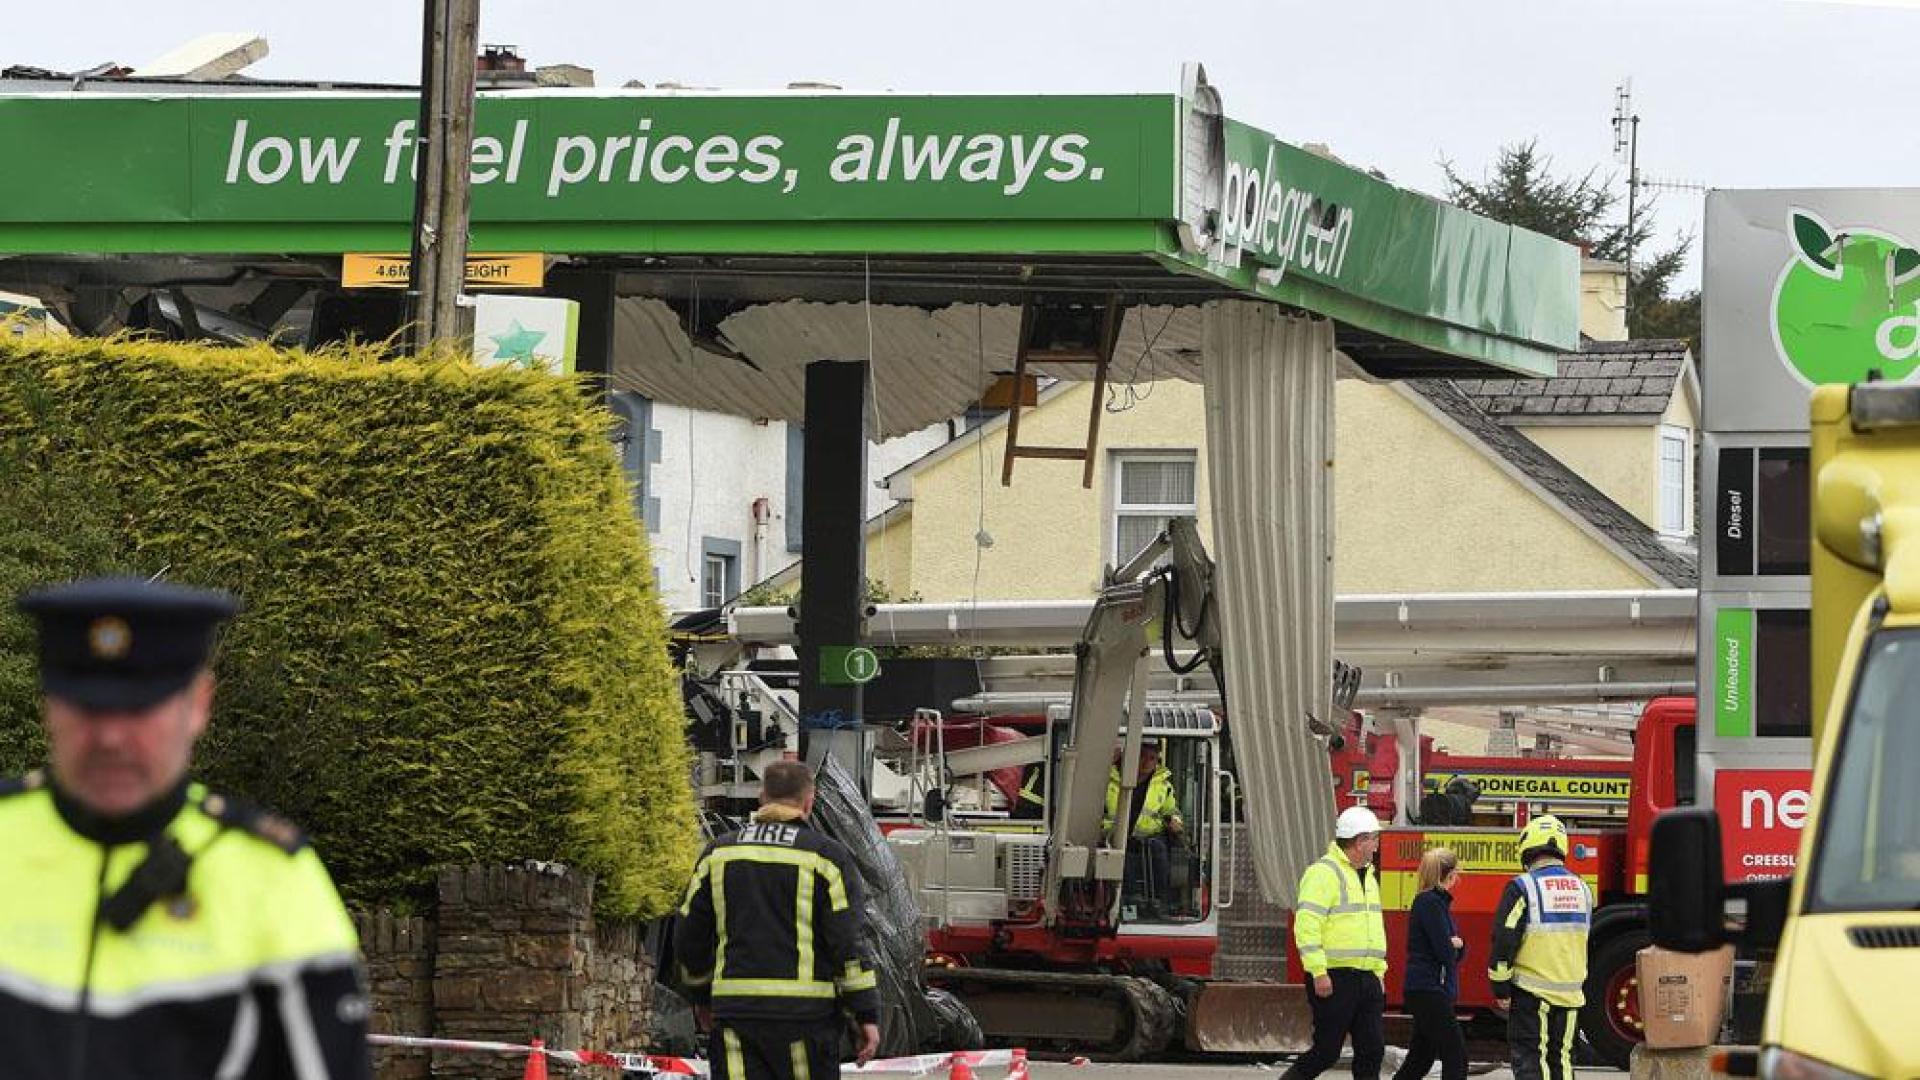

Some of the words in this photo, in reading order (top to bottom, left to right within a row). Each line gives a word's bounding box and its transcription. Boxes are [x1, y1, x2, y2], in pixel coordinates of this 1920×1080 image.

[226, 119, 360, 184] low
[384, 119, 528, 184] fel
[547, 119, 798, 197] prices,
[829, 118, 1105, 196] always.
[1219, 144, 1353, 287] pplegreen
[376, 265, 410, 277] 4.6M
[465, 265, 511, 278] EIGHT
[1727, 490, 1743, 539] Diesel
[855, 655, 865, 674] 1
[1725, 638, 1739, 713] Unleaded
[1477, 778, 1562, 793] DONEGAL
[1567, 781, 1629, 795] COUNT
[737, 824, 800, 847] FIRE
[1495, 842, 1519, 863] FIRE
[1742, 854, 1799, 867] CREESL
[1545, 879, 1580, 890] FIRE
